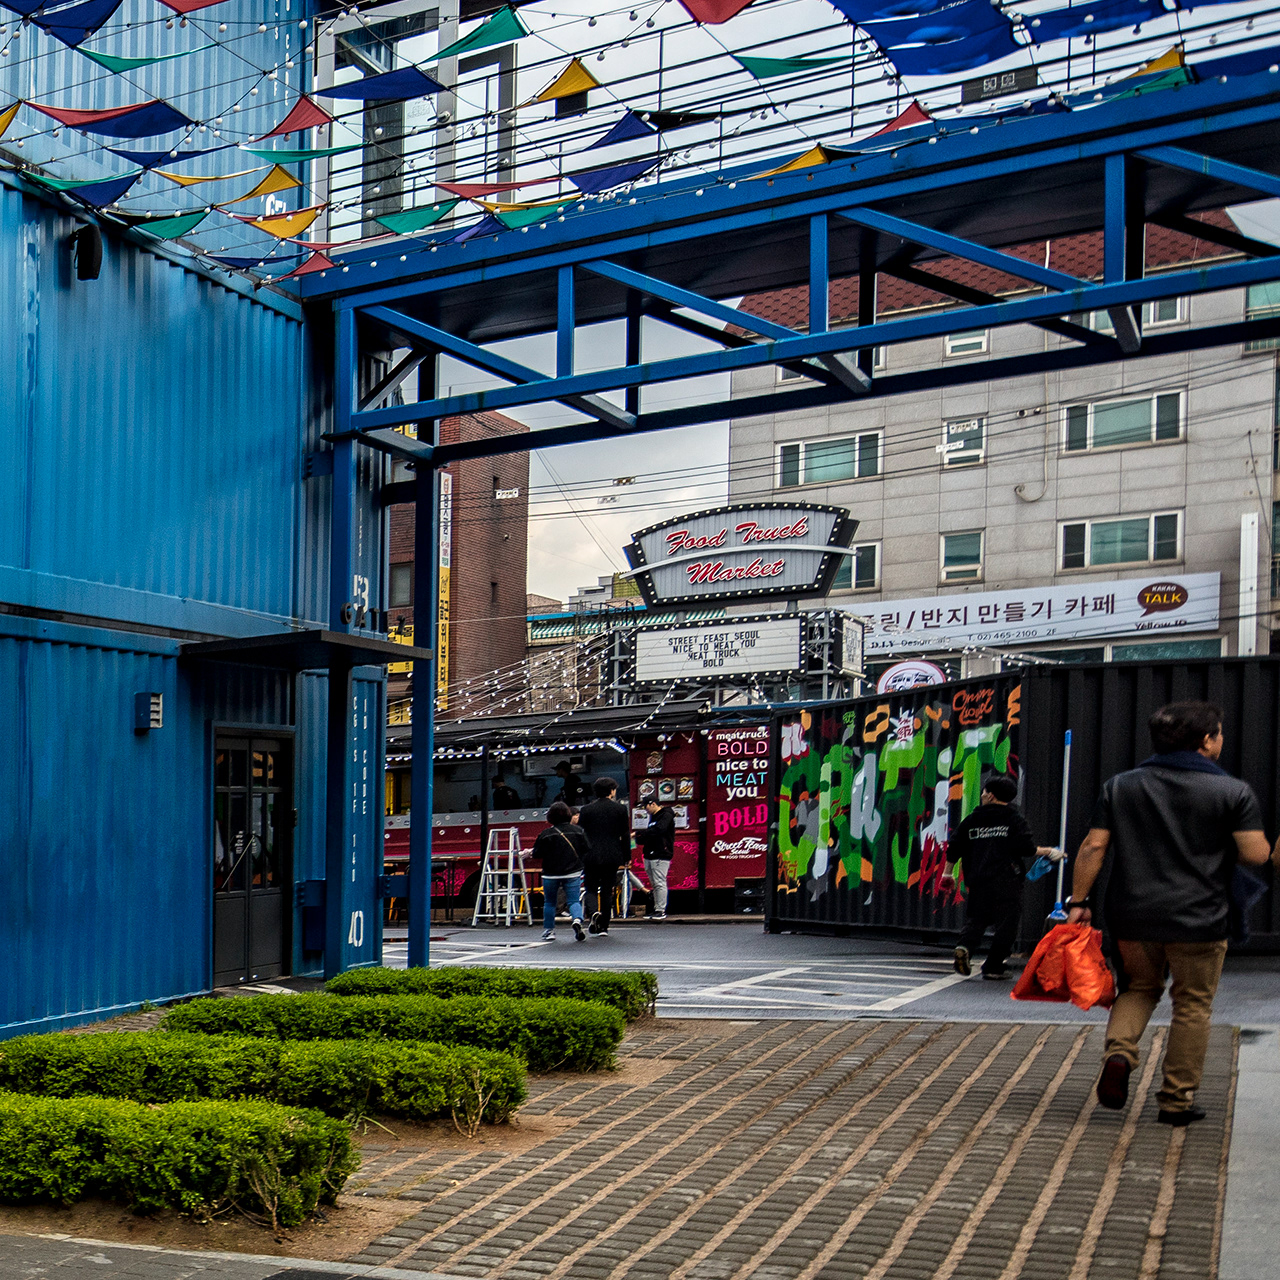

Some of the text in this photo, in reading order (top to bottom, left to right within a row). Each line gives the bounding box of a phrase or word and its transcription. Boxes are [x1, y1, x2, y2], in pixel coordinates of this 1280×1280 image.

[665, 515, 810, 555] Food Truck
[686, 557, 785, 585] Market
[1143, 592, 1183, 604] TALK
[978, 598, 1052, 624] 만들기
[1064, 593, 1116, 617] 카페
[668, 630, 761, 646] STREET FEAST SEOUL
[672, 639, 756, 654] NICE TO MEAT YOU
[687, 648, 740, 661] MEAT TRUCK
[702, 658, 724, 668] BOLD
[716, 731, 741, 740] meat
[717, 741, 768, 756] BOLD
[716, 757, 769, 771] nice to
[716, 771, 768, 786] MEAT
[726, 786, 759, 801] you
[712, 803, 769, 836] BOLD
[711, 838, 743, 854] Street
